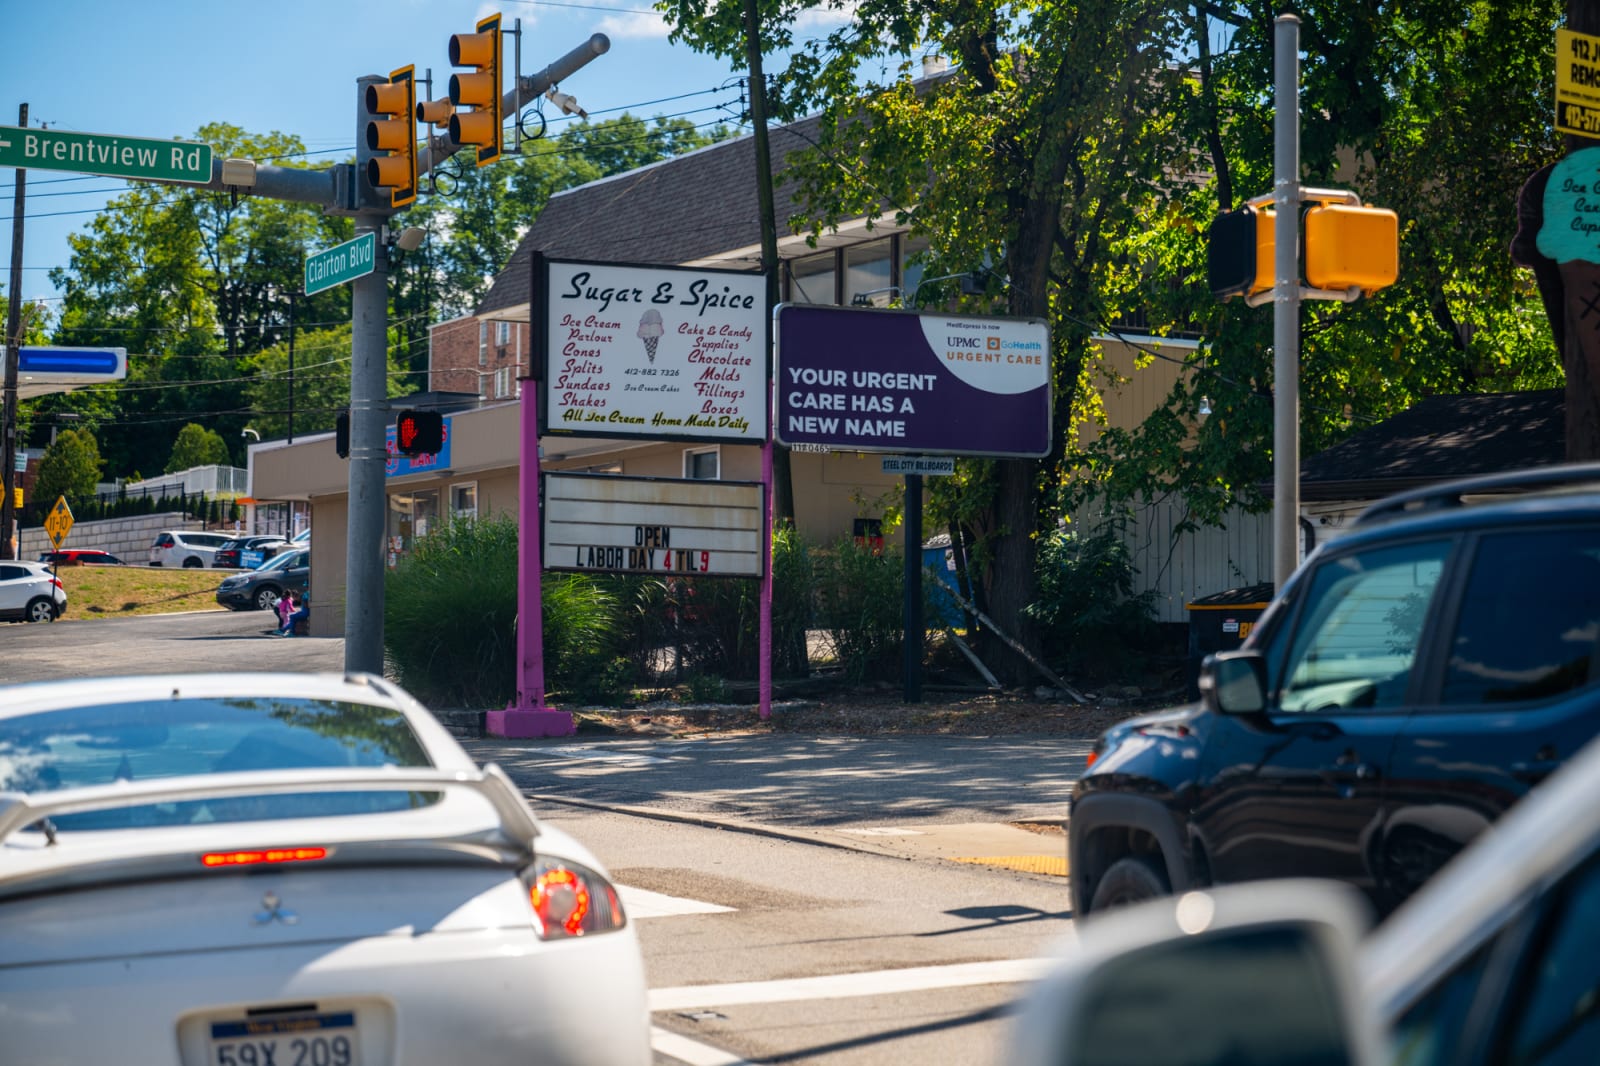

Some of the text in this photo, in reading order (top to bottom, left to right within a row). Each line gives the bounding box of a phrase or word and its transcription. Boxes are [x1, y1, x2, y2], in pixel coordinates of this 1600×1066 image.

[1571, 38, 1600, 62] 412 J
[24, 134, 200, 172] Brentview Rd
[1562, 178, 1586, 193] Ice
[1570, 216, 1600, 237] Cup
[308, 238, 371, 283] Clairton Blvd
[561, 271, 754, 316] Sugar & Spice
[560, 313, 621, 329] Ice Cream
[567, 328, 613, 343] Parlour
[678, 322, 752, 341] Cake & Candy
[562, 342, 601, 358] Cones
[692, 336, 739, 352] Supplies
[947, 336, 1042, 351] UPMC GoHealth
[561, 358, 603, 375] Splits
[687, 349, 752, 367] Chocolate
[946, 351, 1042, 366] URGENT CARE
[554, 374, 611, 391] Sundaes
[699, 367, 741, 382] Molds
[789, 367, 937, 391] YOUR URGENT
[558, 391, 606, 408] Shakes
[693, 382, 745, 403] Fillings
[700, 400, 738, 415] Boxes
[788, 391, 915, 414] CARE HAS A
[562, 408, 749, 434] All Ice Cream Home Made Daily
[788, 416, 906, 437] NEW NAME
[882, 459, 953, 472] STEEL CITY BILLBOARDS
[635, 526, 671, 548] OPEN
[576, 546, 709, 573] LABOR DAY 4 TIL 9
